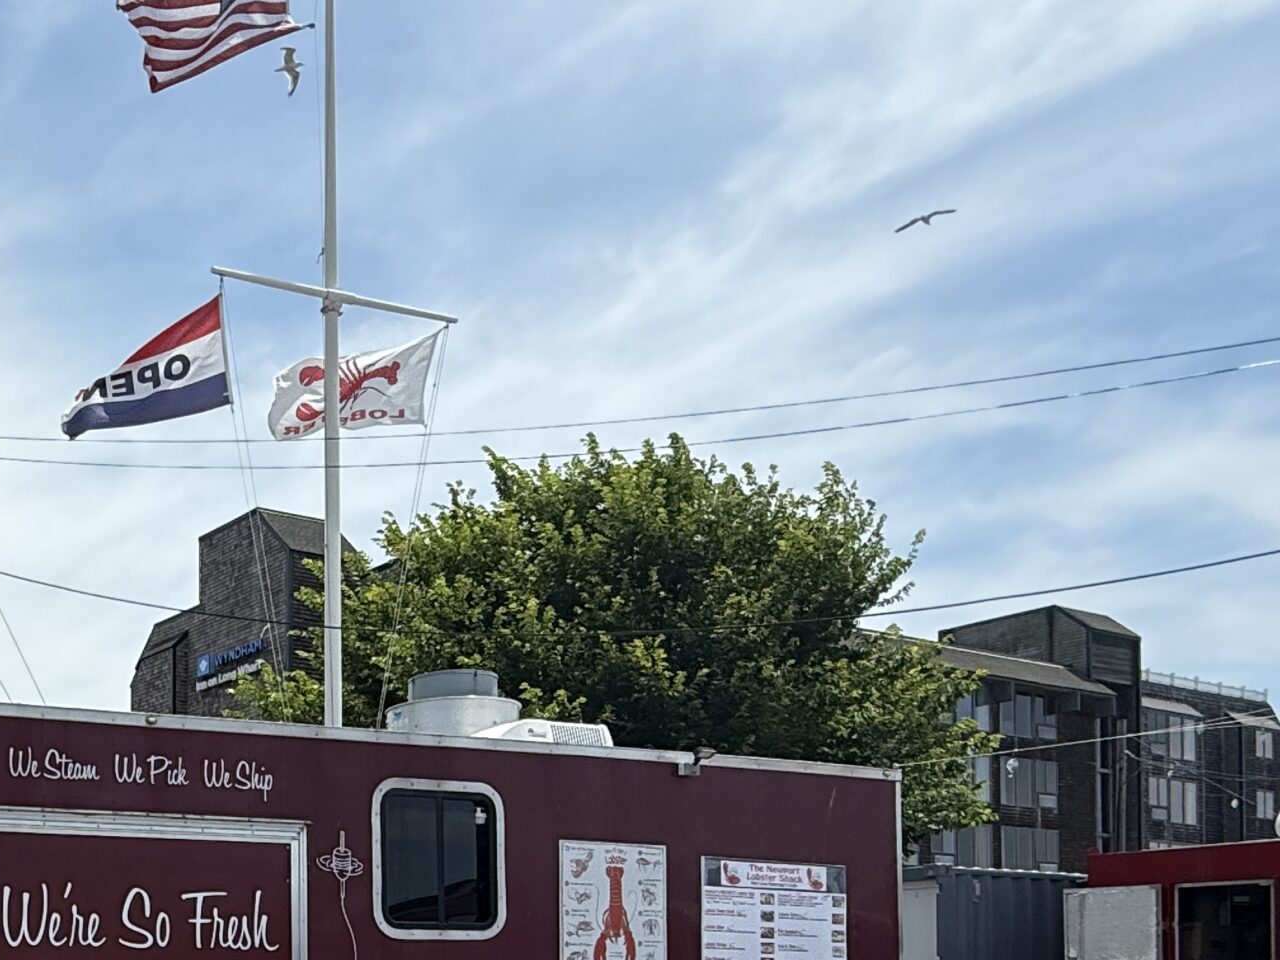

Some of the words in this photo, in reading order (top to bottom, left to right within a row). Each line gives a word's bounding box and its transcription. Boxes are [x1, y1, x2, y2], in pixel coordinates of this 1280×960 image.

[215, 640, 261, 666] WYNDHAM
[218, 670, 236, 683] Long
[9, 747, 41, 778] We
[43, 748, 100, 780] Steam
[115, 753, 145, 783] We
[147, 754, 189, 785] Pick
[204, 758, 233, 788] We
[234, 760, 273, 802] Ship
[2, 882, 106, 947] We're
[119, 887, 171, 949] So
[181, 890, 279, 951] Fresh
